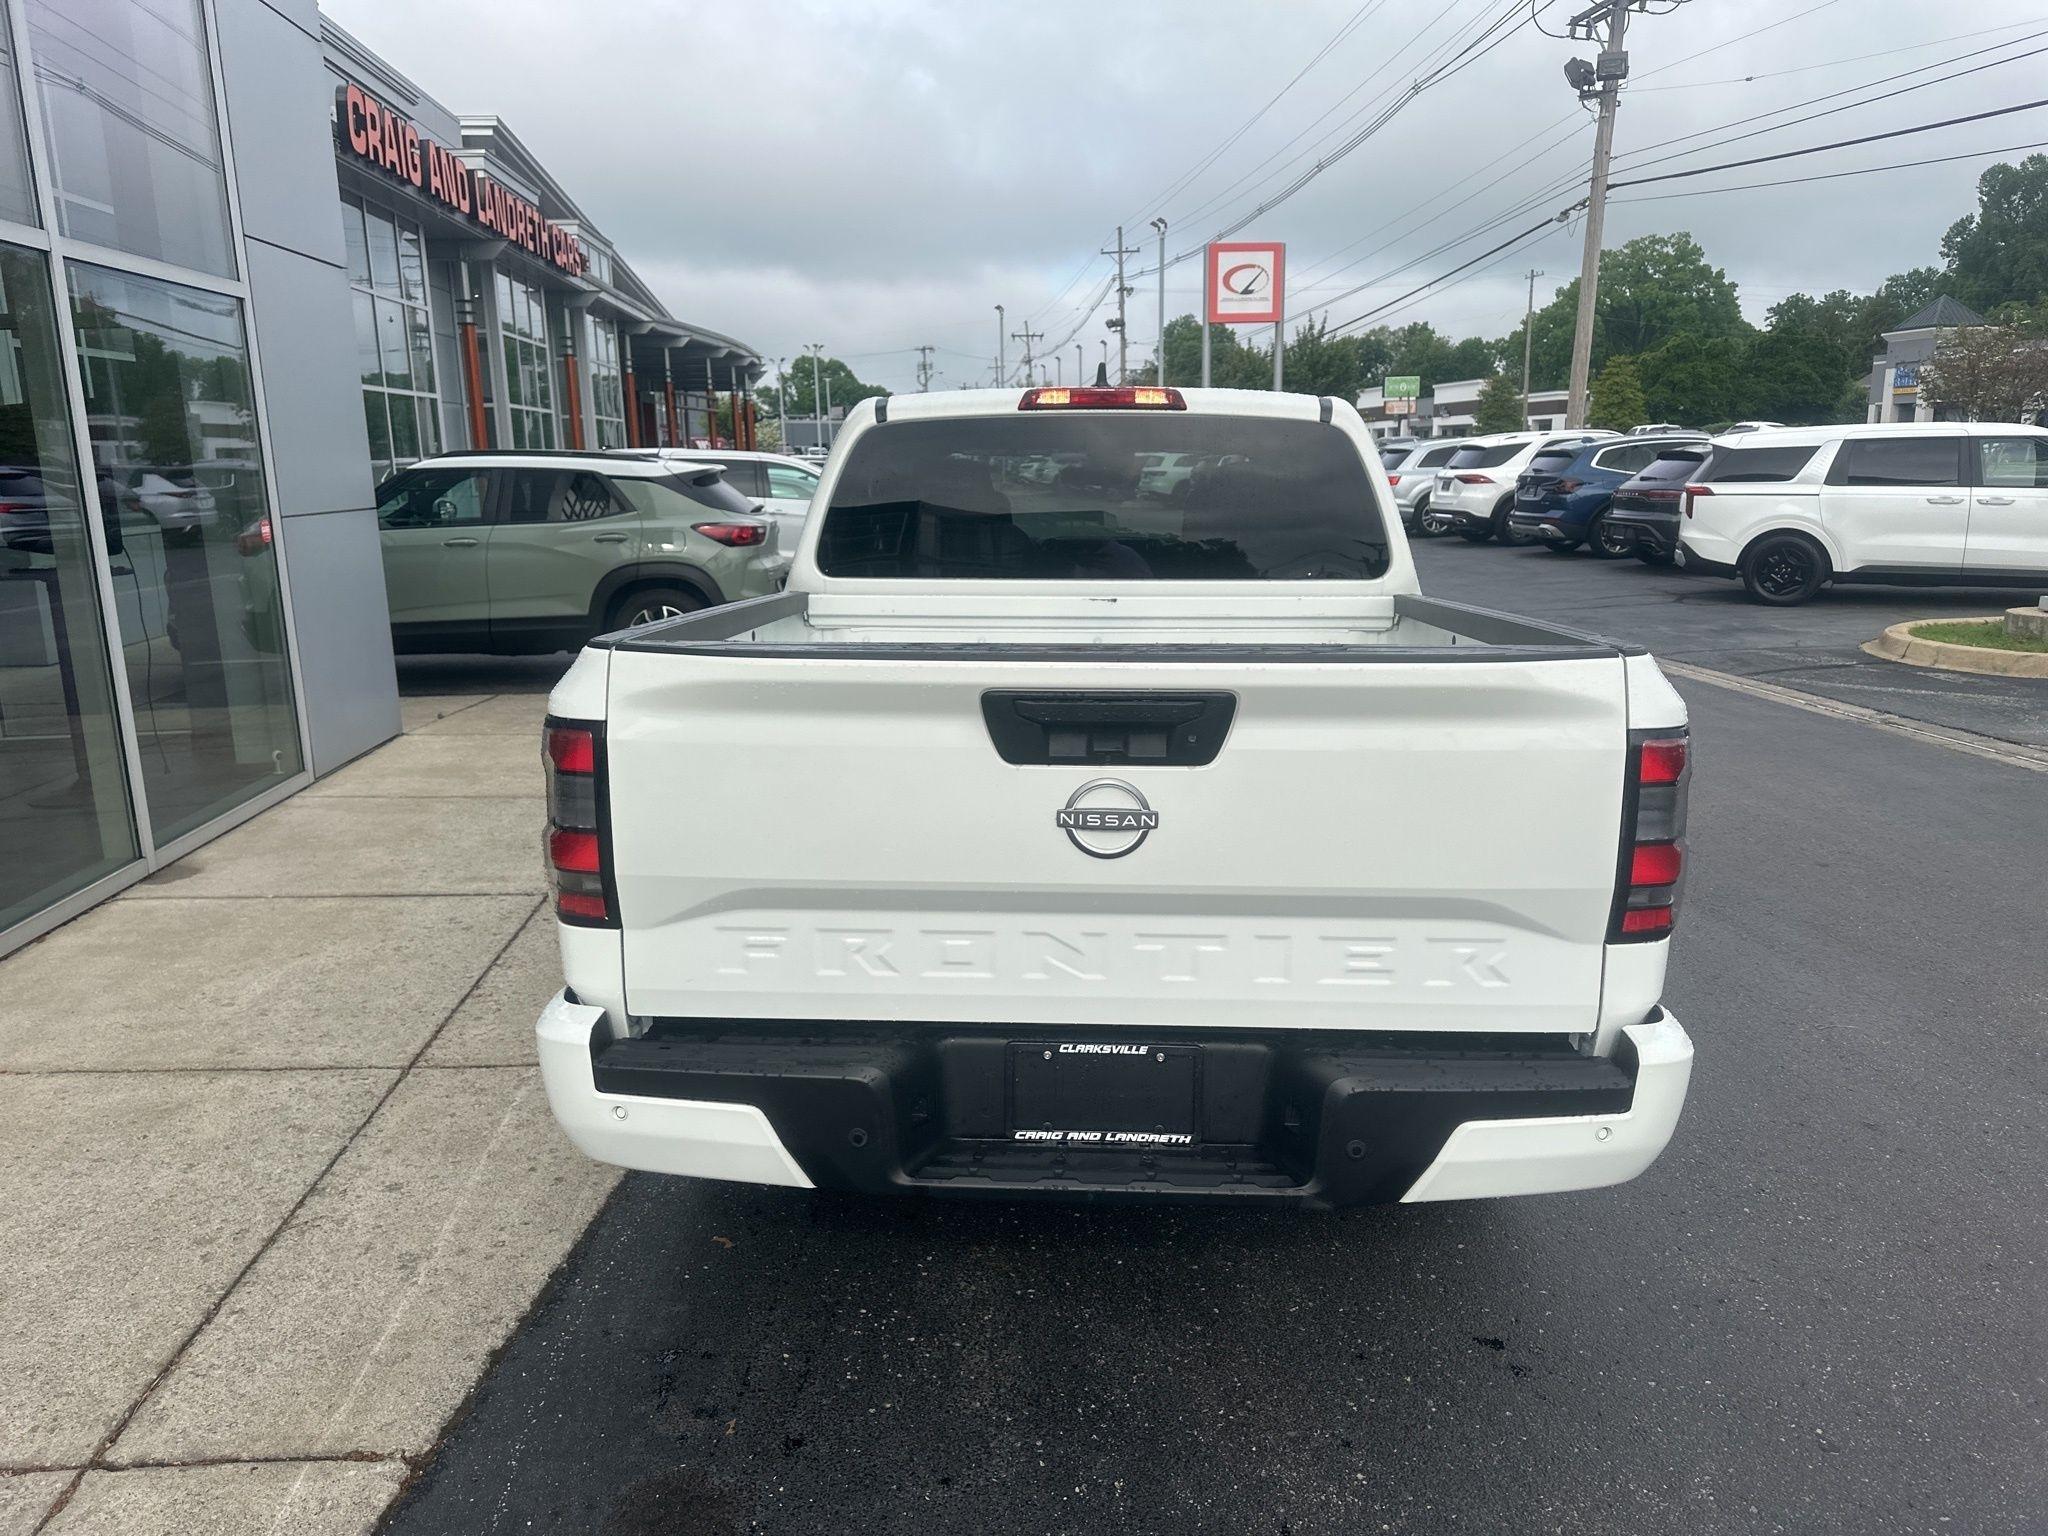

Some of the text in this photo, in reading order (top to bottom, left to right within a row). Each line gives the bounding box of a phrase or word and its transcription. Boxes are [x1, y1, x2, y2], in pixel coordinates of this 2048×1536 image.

[346, 84, 582, 277] CRAIG AND LANDRETH CARS
[1060, 812, 1156, 827] NISSAN
[714, 925, 1512, 988] FRONTIER
[1059, 1043, 1148, 1055] CLARKSVILLE
[1014, 1130, 1192, 1144] CRAIG AND LANDRETH
